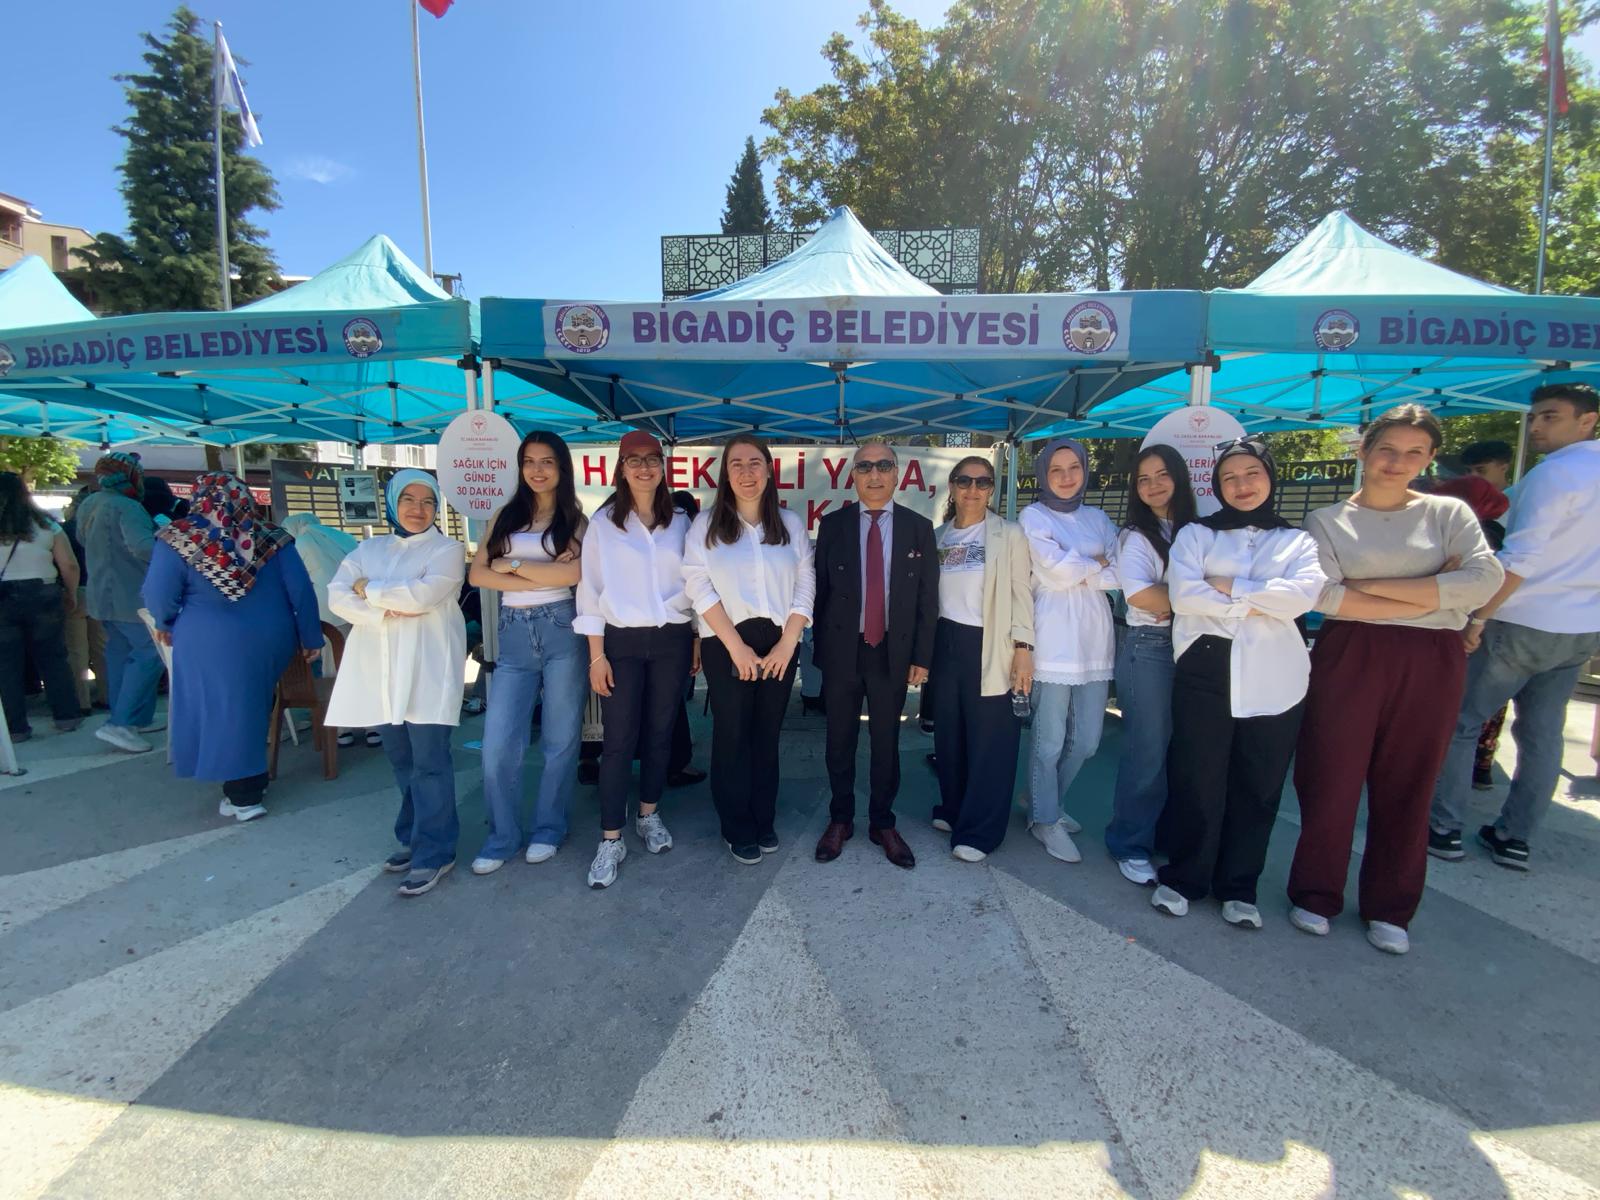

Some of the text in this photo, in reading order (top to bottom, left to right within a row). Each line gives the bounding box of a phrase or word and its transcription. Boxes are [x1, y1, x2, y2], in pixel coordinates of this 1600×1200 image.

[633, 301, 1039, 352] BİGADİÇ BELEDİYESİ
[1378, 309, 1537, 354] BİGADİÇ
[25, 331, 136, 369] BİGADİÇ
[144, 320, 328, 361] BELEDİYESİ
[453, 458, 507, 470] SAĞLIK İÇİN
[464, 472, 496, 483] GÜNDE
[456, 486, 504, 497] 30 DAKİKA
[469, 498, 492, 510] YÜRÜ
